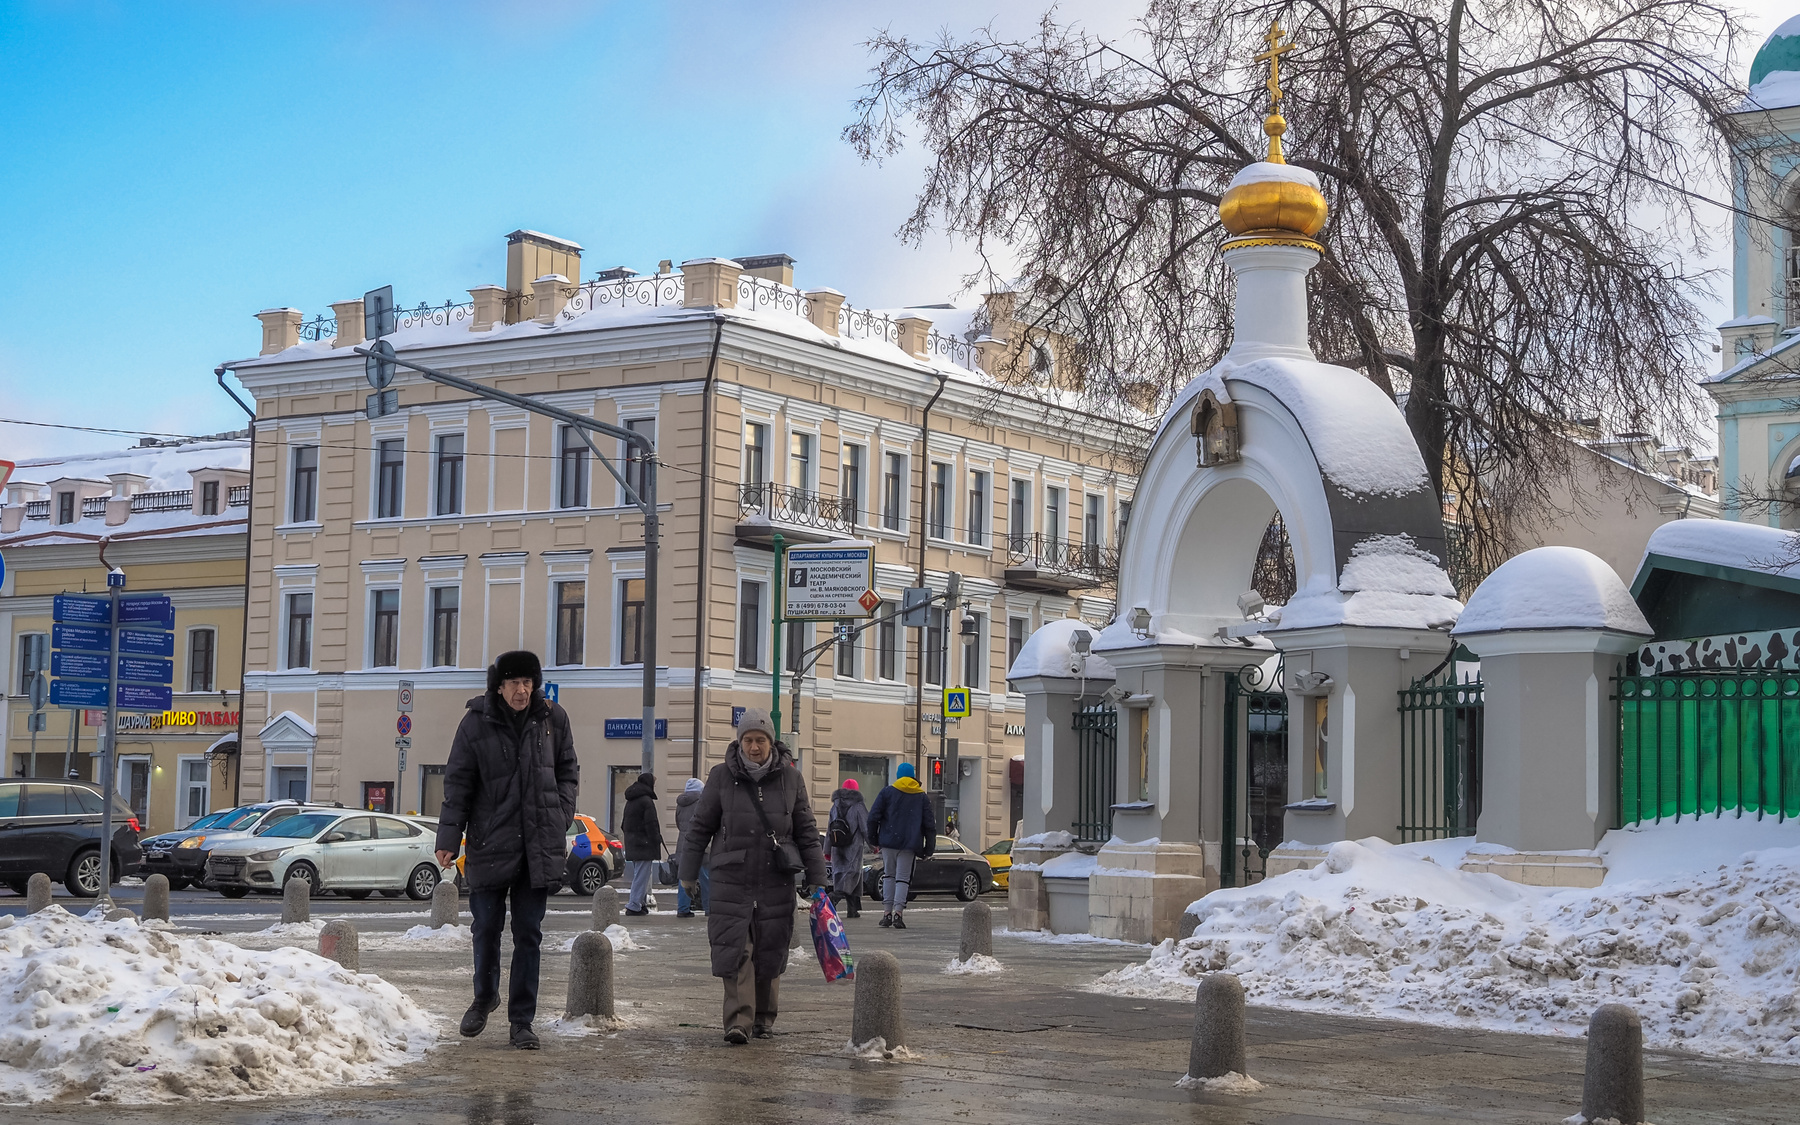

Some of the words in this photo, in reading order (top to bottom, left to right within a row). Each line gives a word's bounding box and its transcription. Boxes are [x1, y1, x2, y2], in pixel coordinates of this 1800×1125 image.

[118, 716, 151, 729] ШАУРМА
[151, 716, 162, 729] 24
[163, 711, 197, 726] ПИВО
[198, 711, 239, 725] ТАБАК
